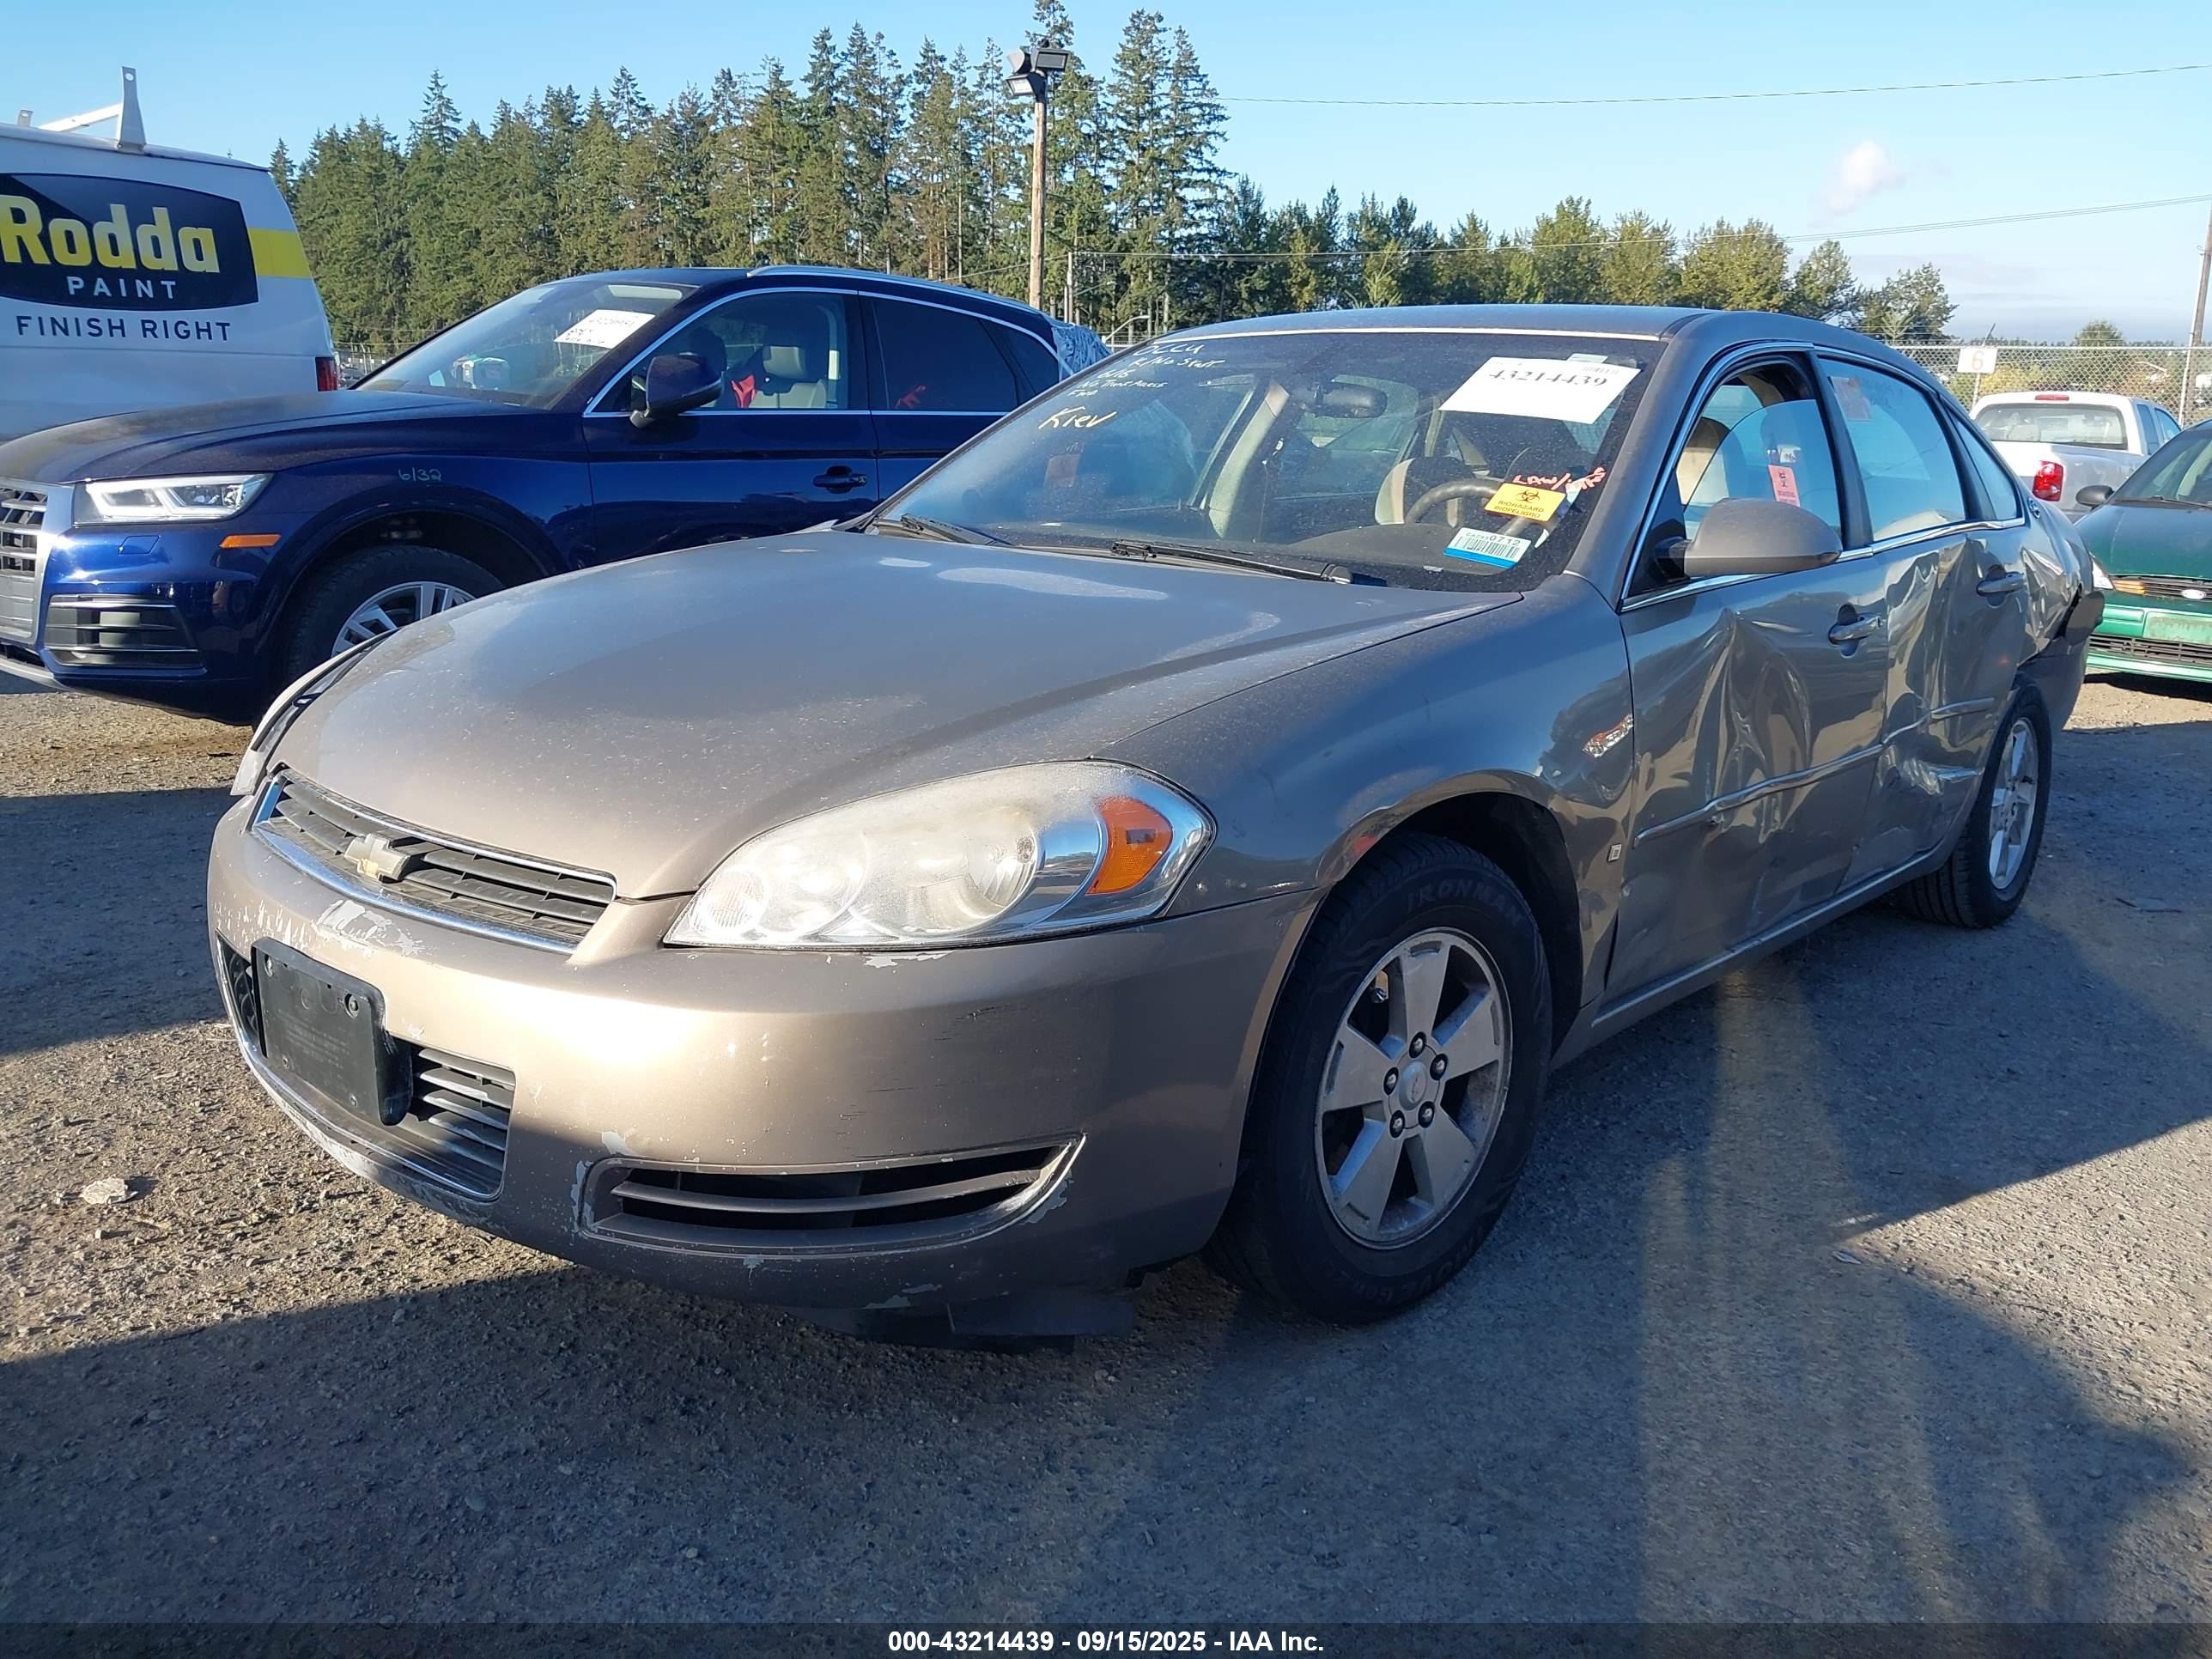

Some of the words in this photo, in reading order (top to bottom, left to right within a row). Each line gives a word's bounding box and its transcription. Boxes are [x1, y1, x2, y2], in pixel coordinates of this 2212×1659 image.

[0, 194, 220, 274] Rodda
[67, 276, 177, 299] PAINT
[16, 315, 126, 338] FINISH
[141, 319, 231, 341] RIGHT
[1972, 350, 1984, 371] 6
[1489, 370, 1608, 386] 43214439
[398, 467, 441, 481] 6132
[1493, 506, 1540, 518] BIOPELIGRO
[1498, 501, 1544, 513] BIOHAZARD
